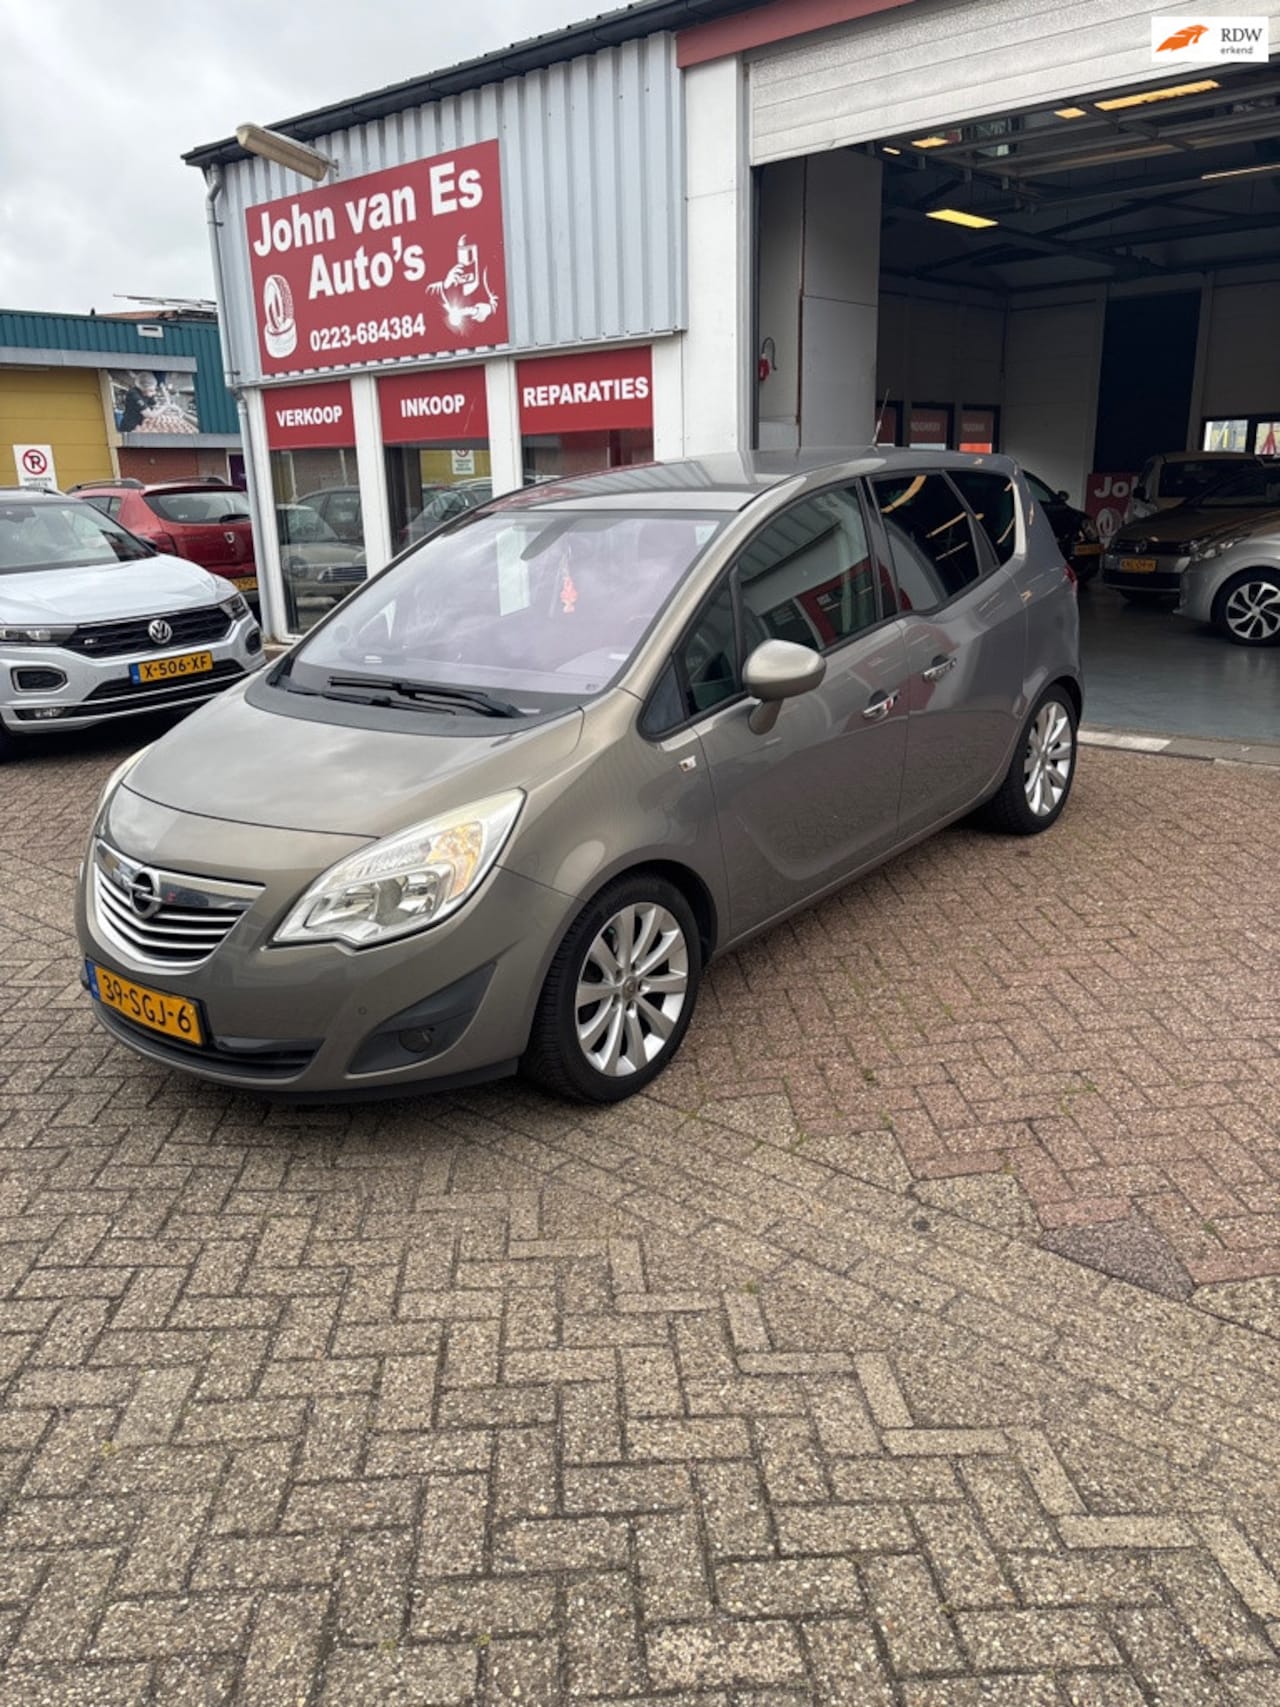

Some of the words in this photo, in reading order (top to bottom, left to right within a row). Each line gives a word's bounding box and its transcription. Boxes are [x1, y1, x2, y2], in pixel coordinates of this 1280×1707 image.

[253, 203, 336, 257] John
[345, 185, 417, 235] van
[429, 161, 483, 216] Es
[308, 234, 426, 300] Auto's
[309, 312, 426, 352] 0223-684384
[400, 393, 466, 418] INKOOP
[522, 376, 650, 408] REPARATIES
[276, 405, 343, 428] VERKOOP
[144, 655, 207, 679] X-506-XF
[102, 975, 191, 1033] 39-SGJ-6
